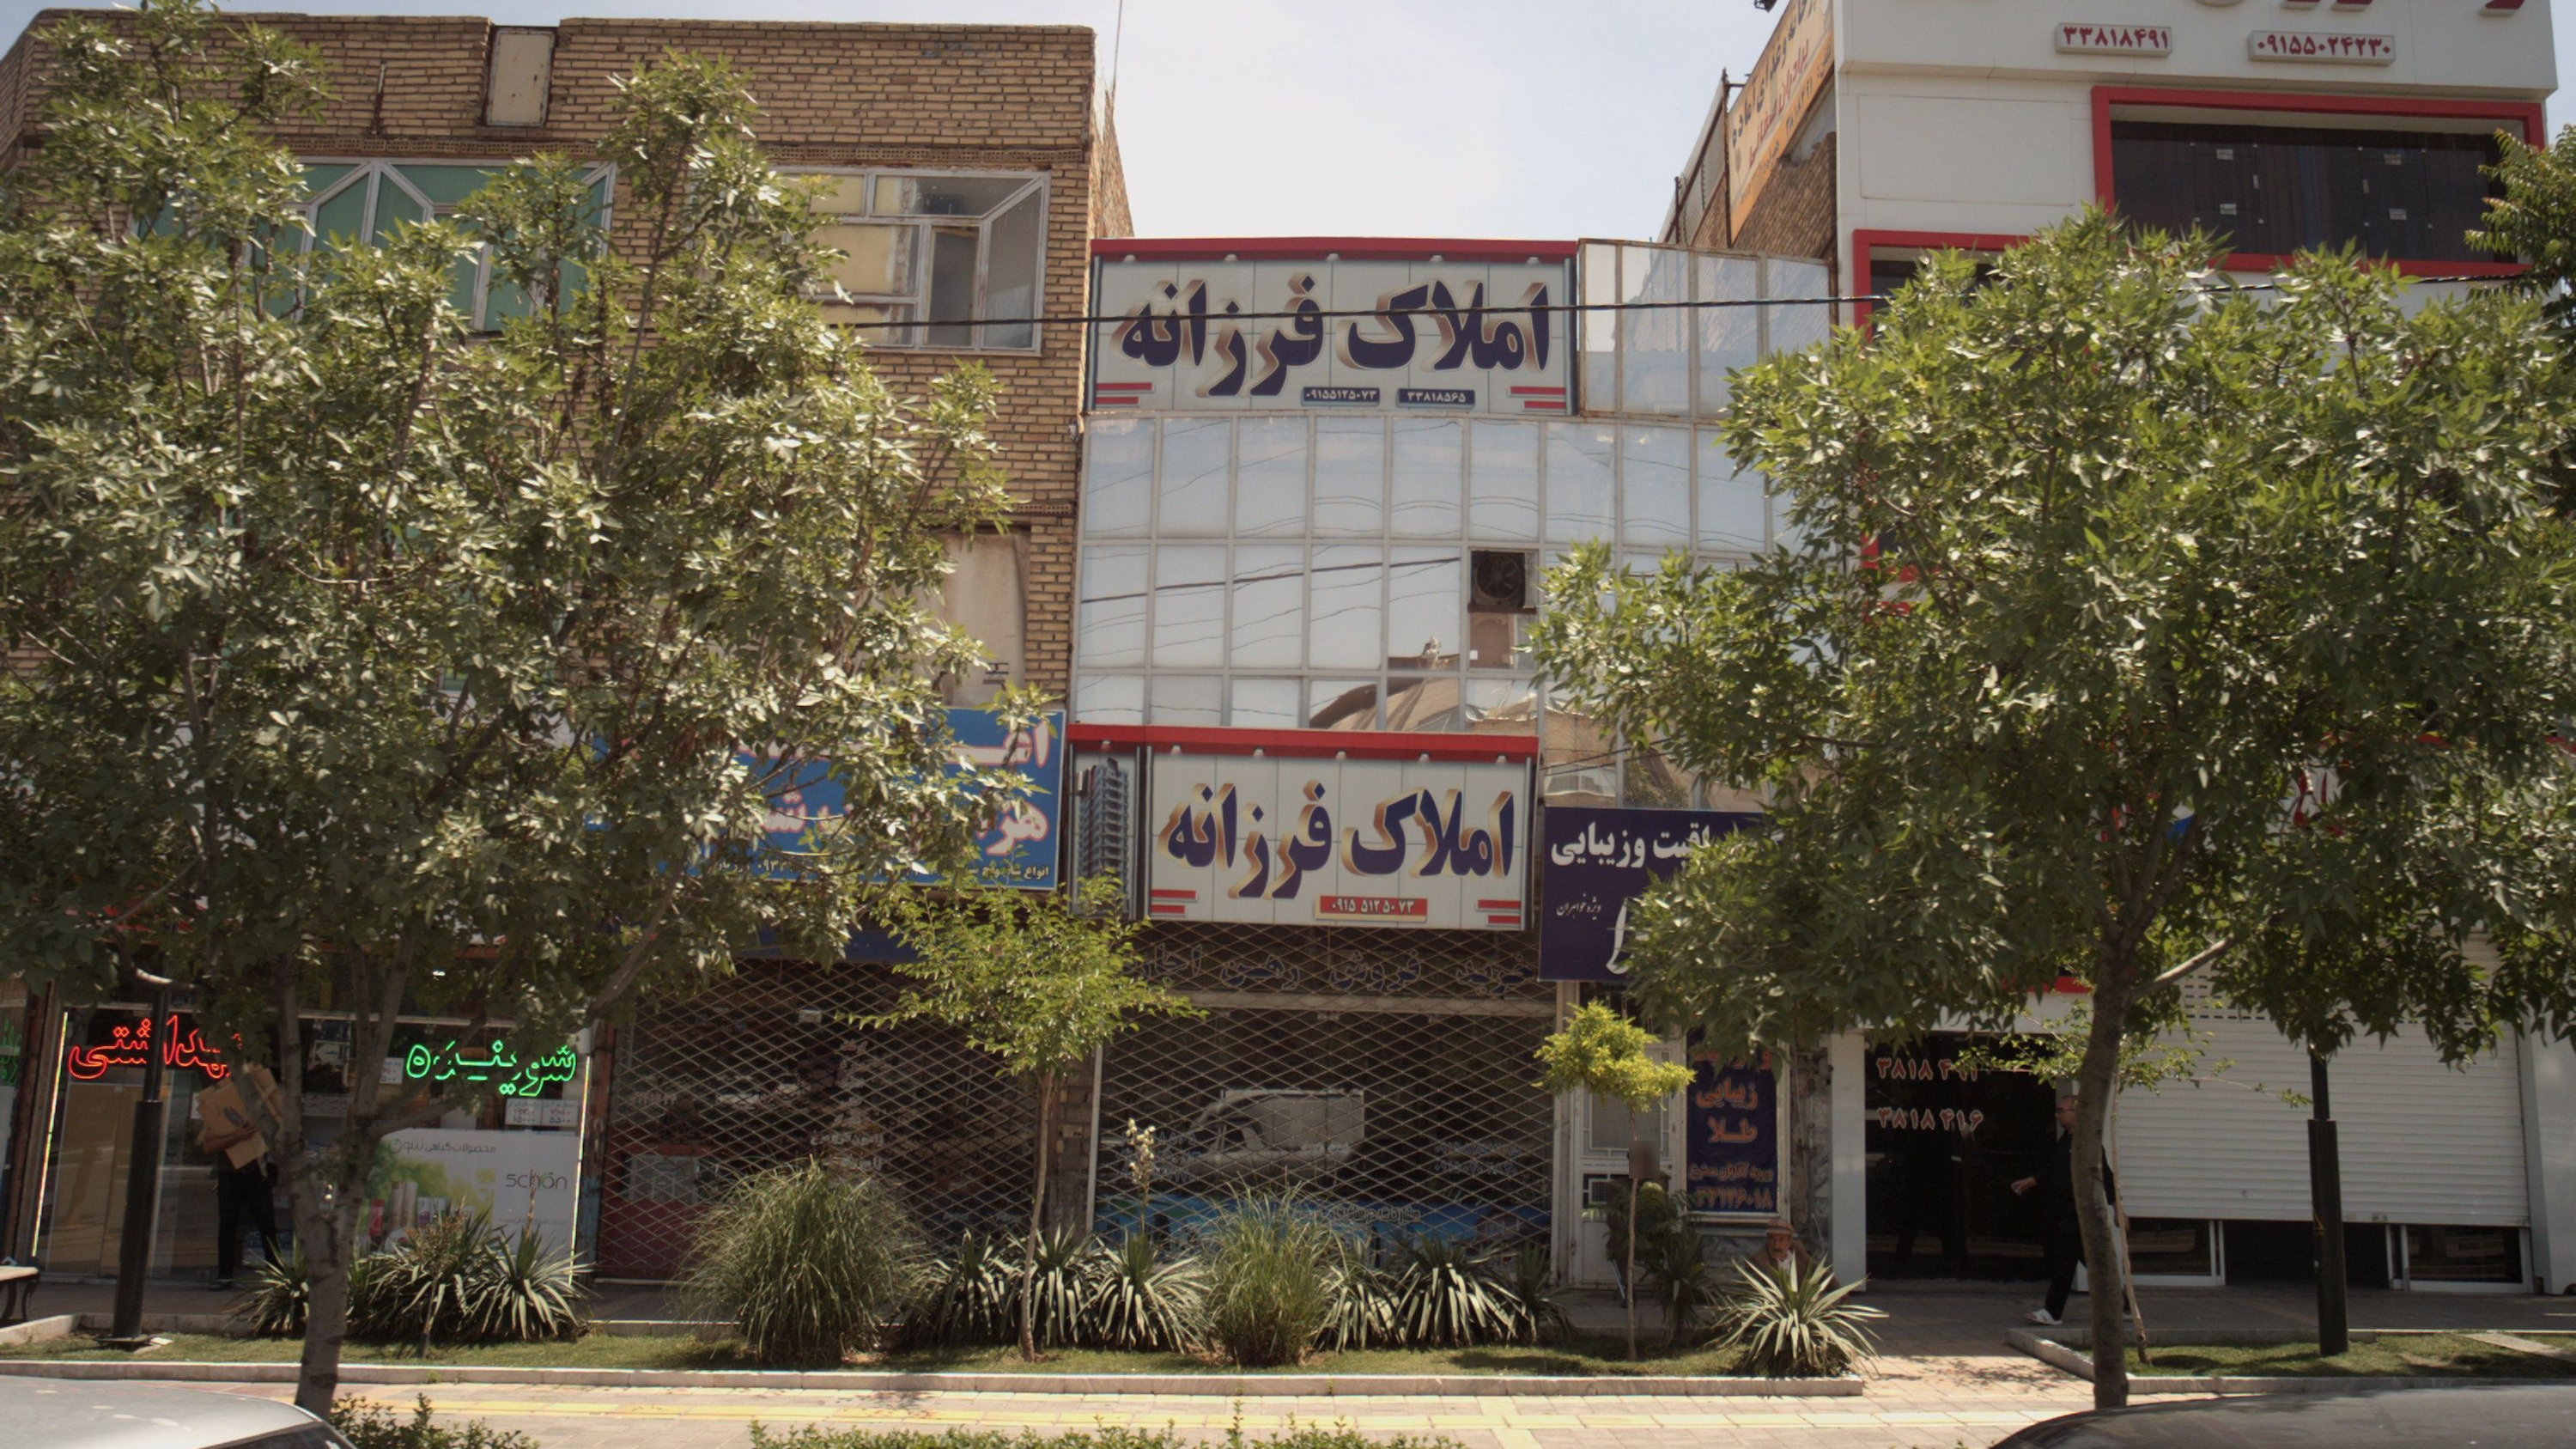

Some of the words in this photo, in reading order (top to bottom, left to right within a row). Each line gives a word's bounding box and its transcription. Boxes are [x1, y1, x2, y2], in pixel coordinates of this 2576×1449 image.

[2063, 25, 2168, 50] ۳۳۸۱۸۴۹۱
[2257, 33, 2391, 57] ۰۹۱۵۵۰۲۴۲۳۰
[1111, 272, 1324, 398] فرزانه
[1336, 279, 1549, 372] املاک
[1157, 780, 1333, 900] فرزانه
[1341, 786, 1515, 879] املاک
[68, 1014, 240, 1080] هداشتی
[1695, 1075, 1759, 1110] زیبایی
[1707, 1116, 1759, 1144] طلا
